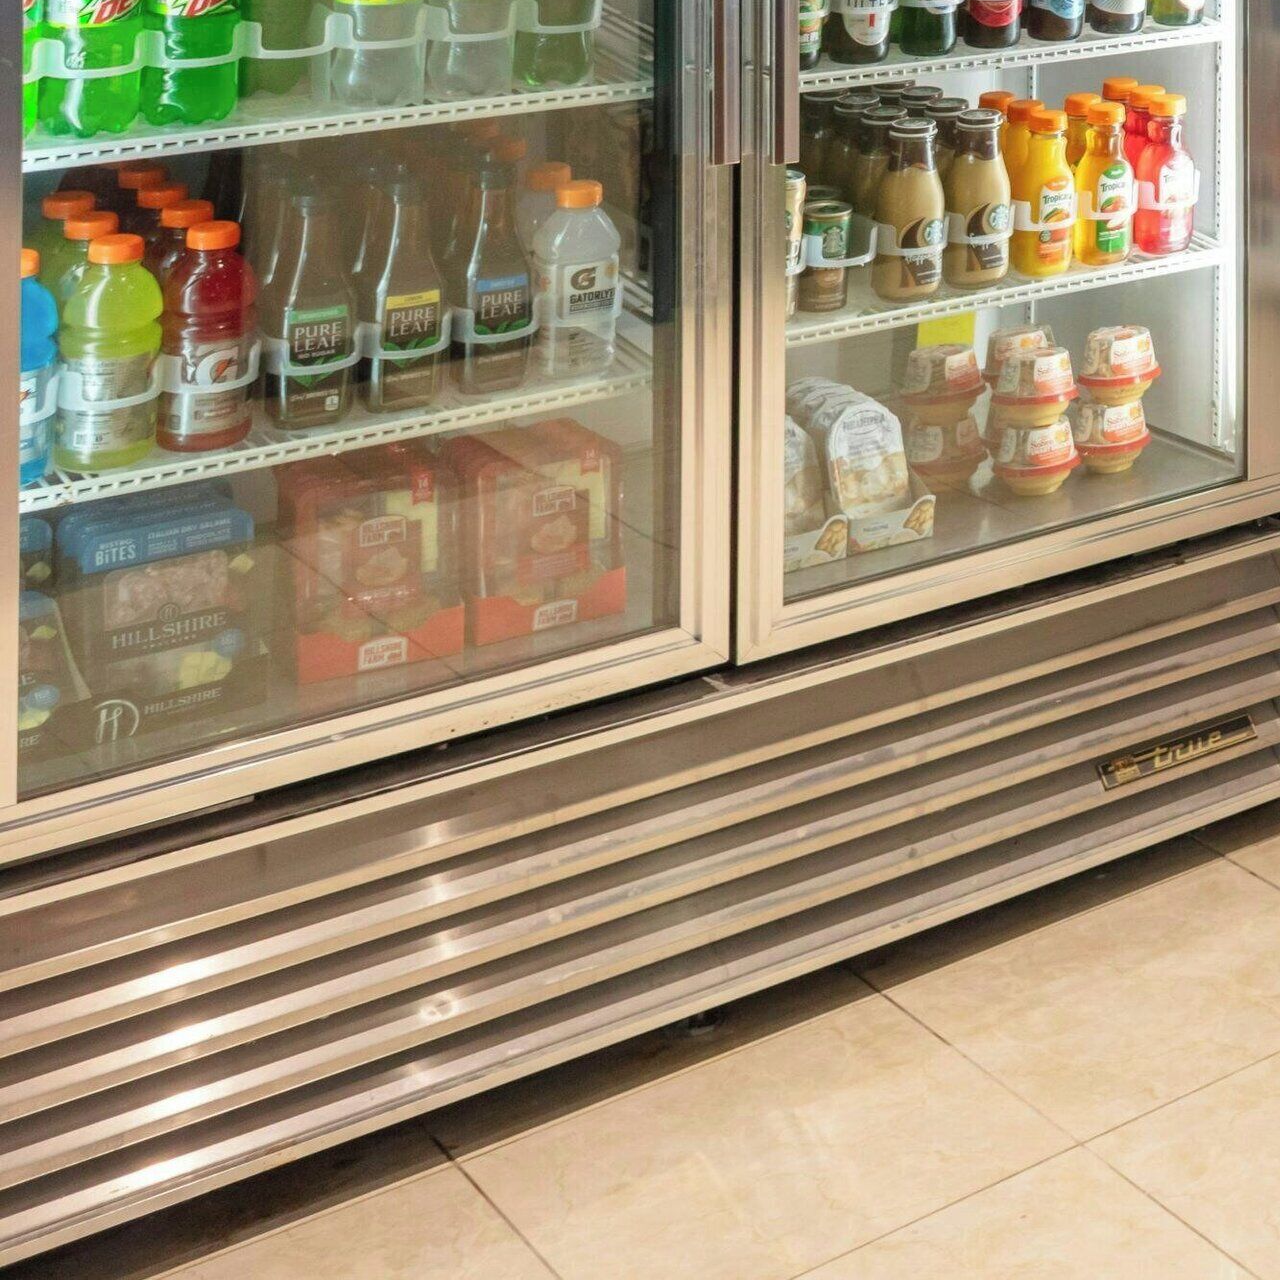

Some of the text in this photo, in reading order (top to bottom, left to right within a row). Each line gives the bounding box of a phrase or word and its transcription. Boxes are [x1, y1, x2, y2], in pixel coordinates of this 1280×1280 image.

[481, 291, 522, 306] PURE
[391, 308, 434, 324] PURE
[481, 303, 522, 320] LEAF
[294, 322, 342, 339] PURE
[390, 321, 435, 337] LEAF
[294, 336, 341, 352] LEAF
[112, 612, 227, 649] HILLSHIRE
[144, 687, 222, 714] HILLSHIRE
